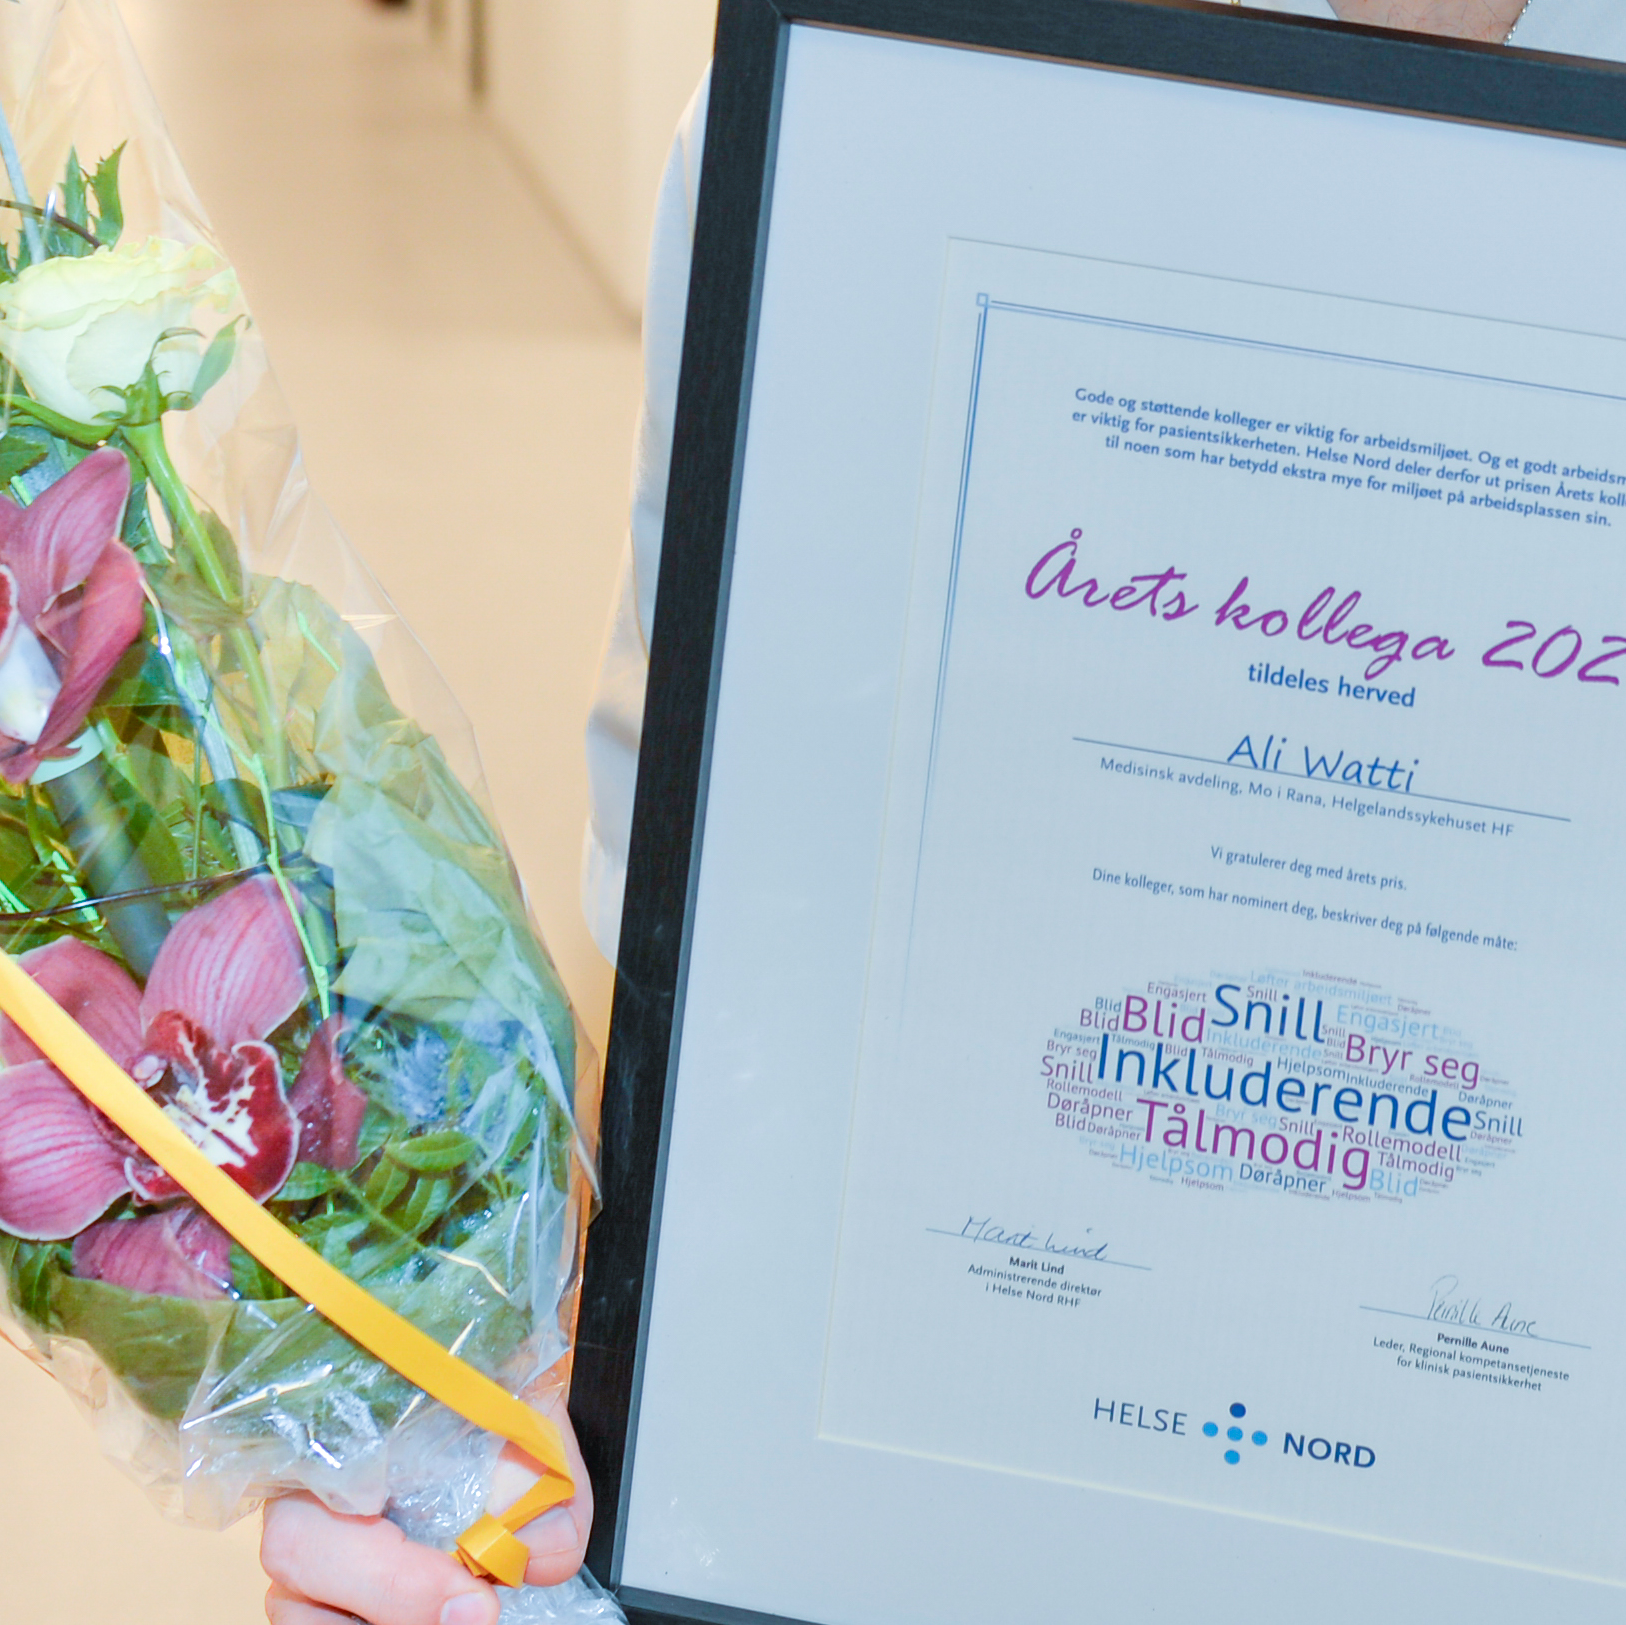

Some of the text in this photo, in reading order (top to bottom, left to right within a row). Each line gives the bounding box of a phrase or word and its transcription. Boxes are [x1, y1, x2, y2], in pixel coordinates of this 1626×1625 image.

[1074, 387, 1115, 406] Gode
[1117, 397, 1138, 414] og
[1140, 399, 1211, 422] støttende
[1213, 407, 1273, 433] kolleger
[1275, 421, 1292, 434] er
[1294, 421, 1335, 445] viktig
[1338, 426, 1361, 444] for
[1362, 433, 1473, 463] arbeidsmiljøet.
[1477, 450, 1502, 471] Og
[1504, 456, 1520, 470] et
[1522, 459, 1558, 476] godt
[1071, 411, 1088, 423] er
[1090, 411, 1131, 434] viktig
[1134, 416, 1156, 434] for
[1157, 424, 1301, 458] pasientsikkerheten.
[1305, 444, 1349, 465] Helse
[1352, 451, 1392, 471] Nord
[1394, 458, 1433, 477] deler
[1435, 464, 1482, 485] derfor
[1484, 475, 1501, 489] ut
[1503, 477, 1552, 496] prisen
[1554, 481, 1595, 503] Årets
[1105, 434, 1612, 528] til noen som har betydd ekstra mye for miljøet på arbeidsplassen sin.
[1025, 528, 1200, 621] Årets
[1214, 576, 1456, 680] kollega
[1247, 662, 1417, 708] tildeles herved
[1226, 734, 1419, 792] Ali Watti
[1099, 756, 1515, 837] Medisinsk avdeling, Mo i Rana, Helgelandssykehuset HF
[1210, 844, 1407, 891] Vi gratulerer deg med årets pris.
[1091, 866, 1518, 952] Dine kolleger, som har nominert deg, beskriver deg på følgende måte:
[1095, 996, 1122, 1012] Blid
[1147, 981, 1207, 1003] Engasjert
[1246, 985, 1278, 1002] Snill
[1080, 1008, 1120, 1031] Blid
[1123, 994, 1206, 1043] Blid
[1211, 983, 1325, 1043] Snill
[1337, 1004, 1439, 1040] Engasjert
[1207, 1028, 1322, 1059] Inkluderende
[1322, 1024, 1346, 1038] Snill
[1326, 1037, 1346, 1049] Blid
[1047, 1039, 1097, 1061] Bryr seg
[1165, 1043, 1188, 1057] Blid
[1202, 1046, 1254, 1067] Tålmodig
[1345, 1033, 1479, 1091] Bryr seg
[1041, 1055, 1093, 1084] Snill
[1277, 1056, 1346, 1080] Hjelpsom
[1047, 1078, 1123, 1102] Rollemodell
[1098, 1033, 1471, 1141] Inkluderende
[1346, 1072, 1429, 1097] Inkluderende
[1047, 1092, 1133, 1122] Døråpner
[1458, 1091, 1513, 1110] Døråpner
[1055, 1112, 1086, 1131] Blid
[1087, 1121, 1141, 1141] Døråpner
[1278, 1116, 1314, 1136] Snill
[1474, 1110, 1523, 1137] Snill
[1136, 1097, 1370, 1191] Tålmodig
[1342, 1126, 1463, 1162] Rollemodell
[1119, 1143, 1233, 1181] Hjelpsom
[1378, 1151, 1455, 1182] Tålmodig
[1181, 1176, 1224, 1191] Hjelpsom
[1239, 1162, 1327, 1194] Døråpner
[1369, 1167, 1418, 1197] Blid
[967, 1263, 1103, 1298] Administrerende direktør
[1008, 1255, 1066, 1276] Marit Lind
[984, 1281, 1081, 1309] i Helse Nord RHF
[1436, 1331, 1510, 1356] Pernille Aune
[1372, 1336, 1571, 1382] Leder, Regional kompetansetjeneste
[1396, 1355, 1543, 1392] for klinisk pasientsikkerhet
[1094, 1397, 1376, 1469] HELSE NORD
